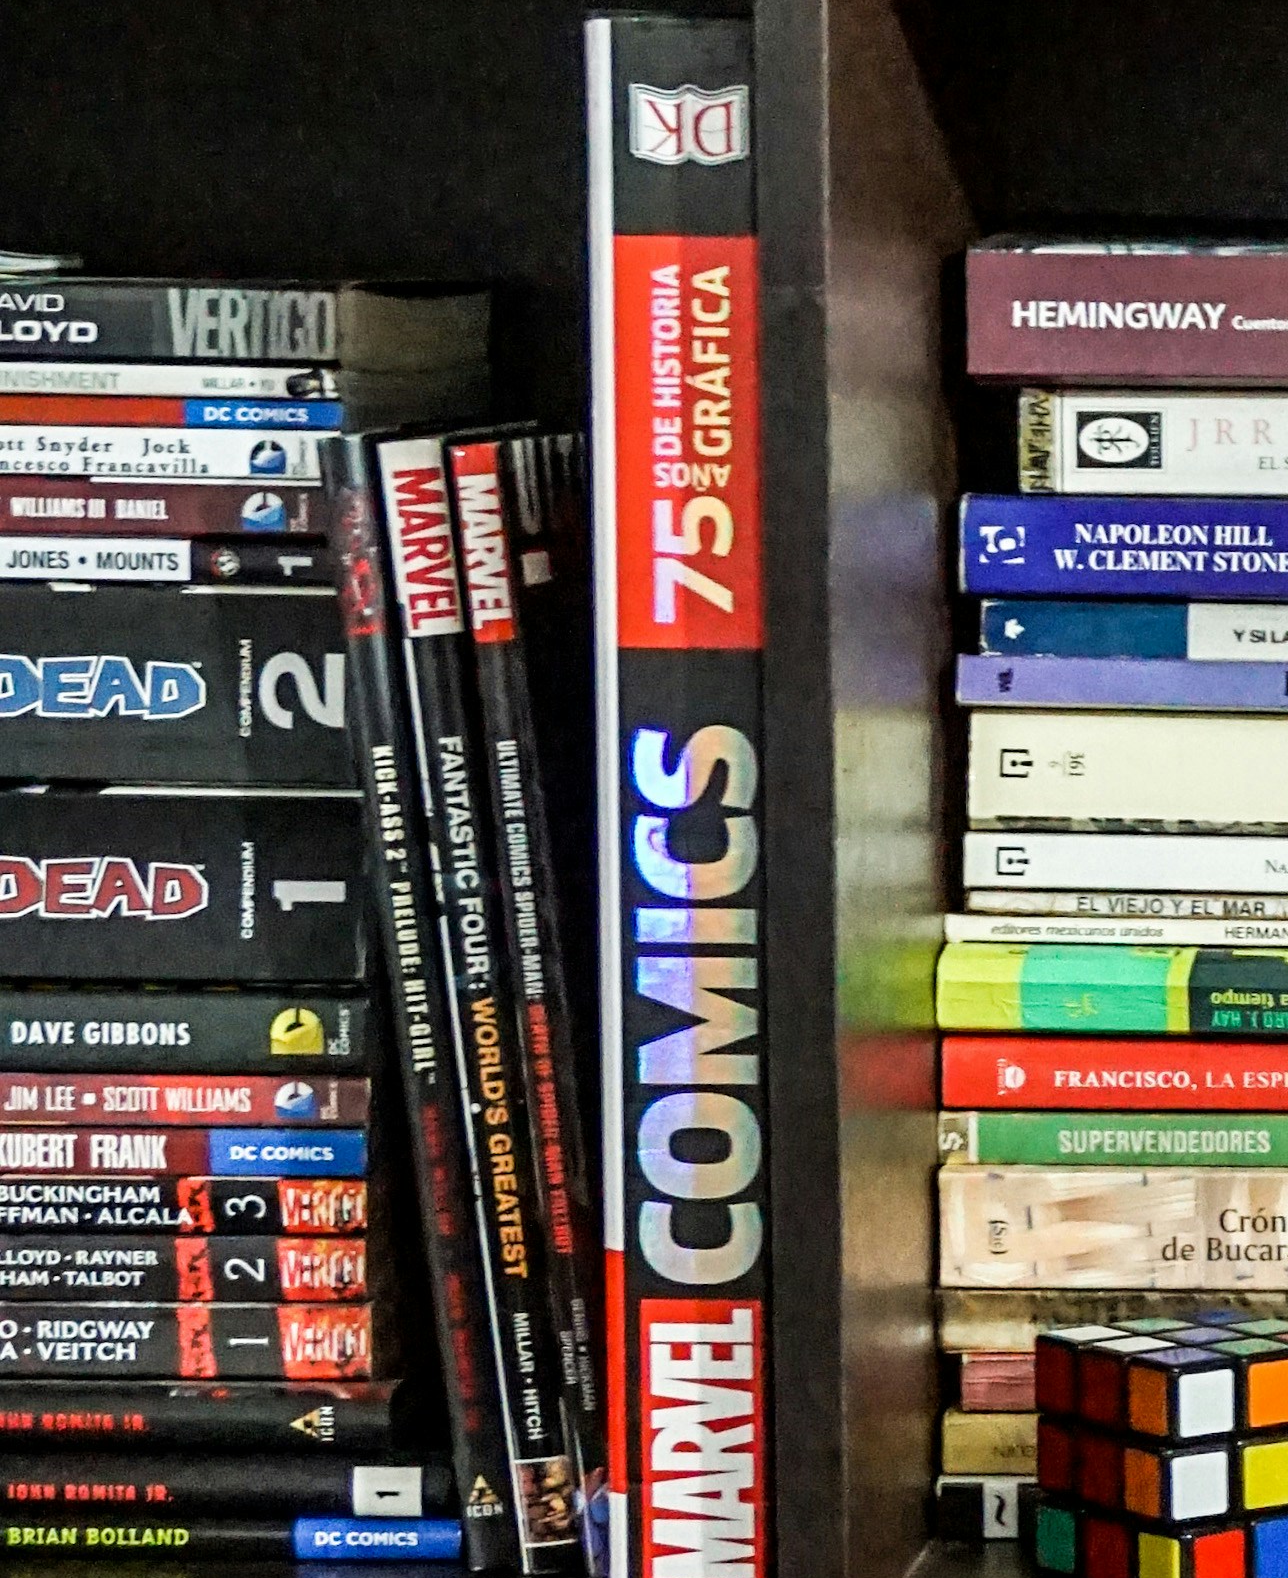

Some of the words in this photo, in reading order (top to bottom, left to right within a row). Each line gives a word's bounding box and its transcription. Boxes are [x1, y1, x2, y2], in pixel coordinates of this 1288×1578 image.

[168, 287, 338, 361] VERTIGO
[1011, 299, 1226, 330] HEMINGWAY
[652, 263, 682, 411] HISTORIA
[688, 267, 732, 457] GRÁFICA
[203, 405, 229, 424] DC
[235, 404, 311, 426] COMICS
[35, 437, 114, 458] Snyder
[142, 437, 191, 458] Jock
[652, 417, 682, 458] DE
[81, 457, 211, 476] Francavilla
[654, 465, 731, 489] AÑOS
[1075, 522, 1207, 546] NAPOLEON
[1215, 524, 1274, 547] HILL
[7, 550, 70, 570] JONES
[96, 551, 179, 572] MOUNTS
[393, 469, 458, 634] MARVEL
[456, 476, 512, 630] MARVEL
[654, 490, 737, 623] 75
[1052, 548, 1085, 572] W.
[1089, 548, 1206, 574] CLEMENT
[0, 655, 205, 721] DEAD
[239, 638, 253, 739] COMPENDIUM
[439, 735, 479, 891] FANTASTIC
[633, 724, 762, 1285] COMICS
[10, 1021, 75, 1047] DAVE
[83, 1021, 192, 1047] GIBBONS
[473, 998, 509, 1126] WORLD'S
[1054, 1070, 1198, 1091] FRANCISCO,
[1205, 1071, 1235, 1088] LA
[1053, 1125, 1276, 1155] SUPERVENDEDORES
[488, 1131, 527, 1279] GREATEST
[1160, 1236, 1196, 1262] de
[8, 1526, 76, 1548] BRIAN
[85, 1526, 190, 1548] BOLLAND
